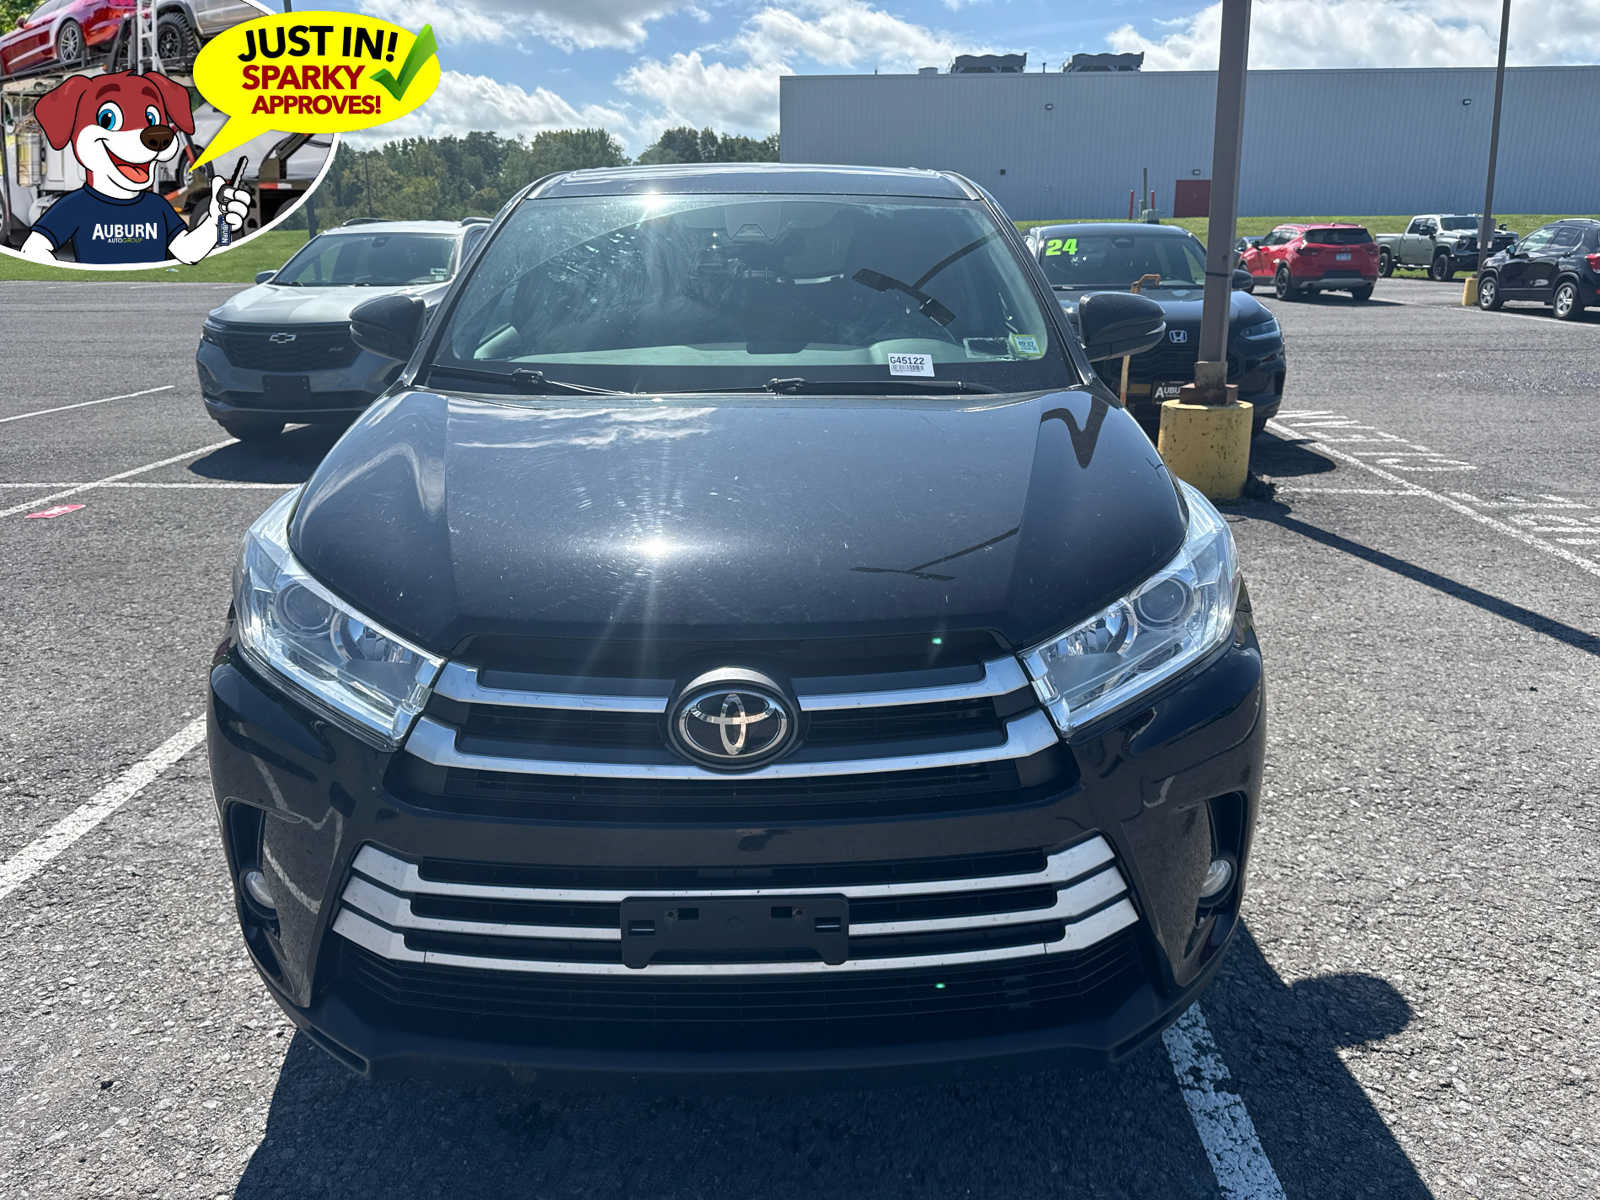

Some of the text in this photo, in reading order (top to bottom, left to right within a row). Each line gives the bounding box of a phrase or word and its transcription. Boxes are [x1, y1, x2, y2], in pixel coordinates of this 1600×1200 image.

[1046, 238, 1078, 256] 24
[890, 356, 925, 365] G45122
[1154, 386, 1181, 398] AUBU
